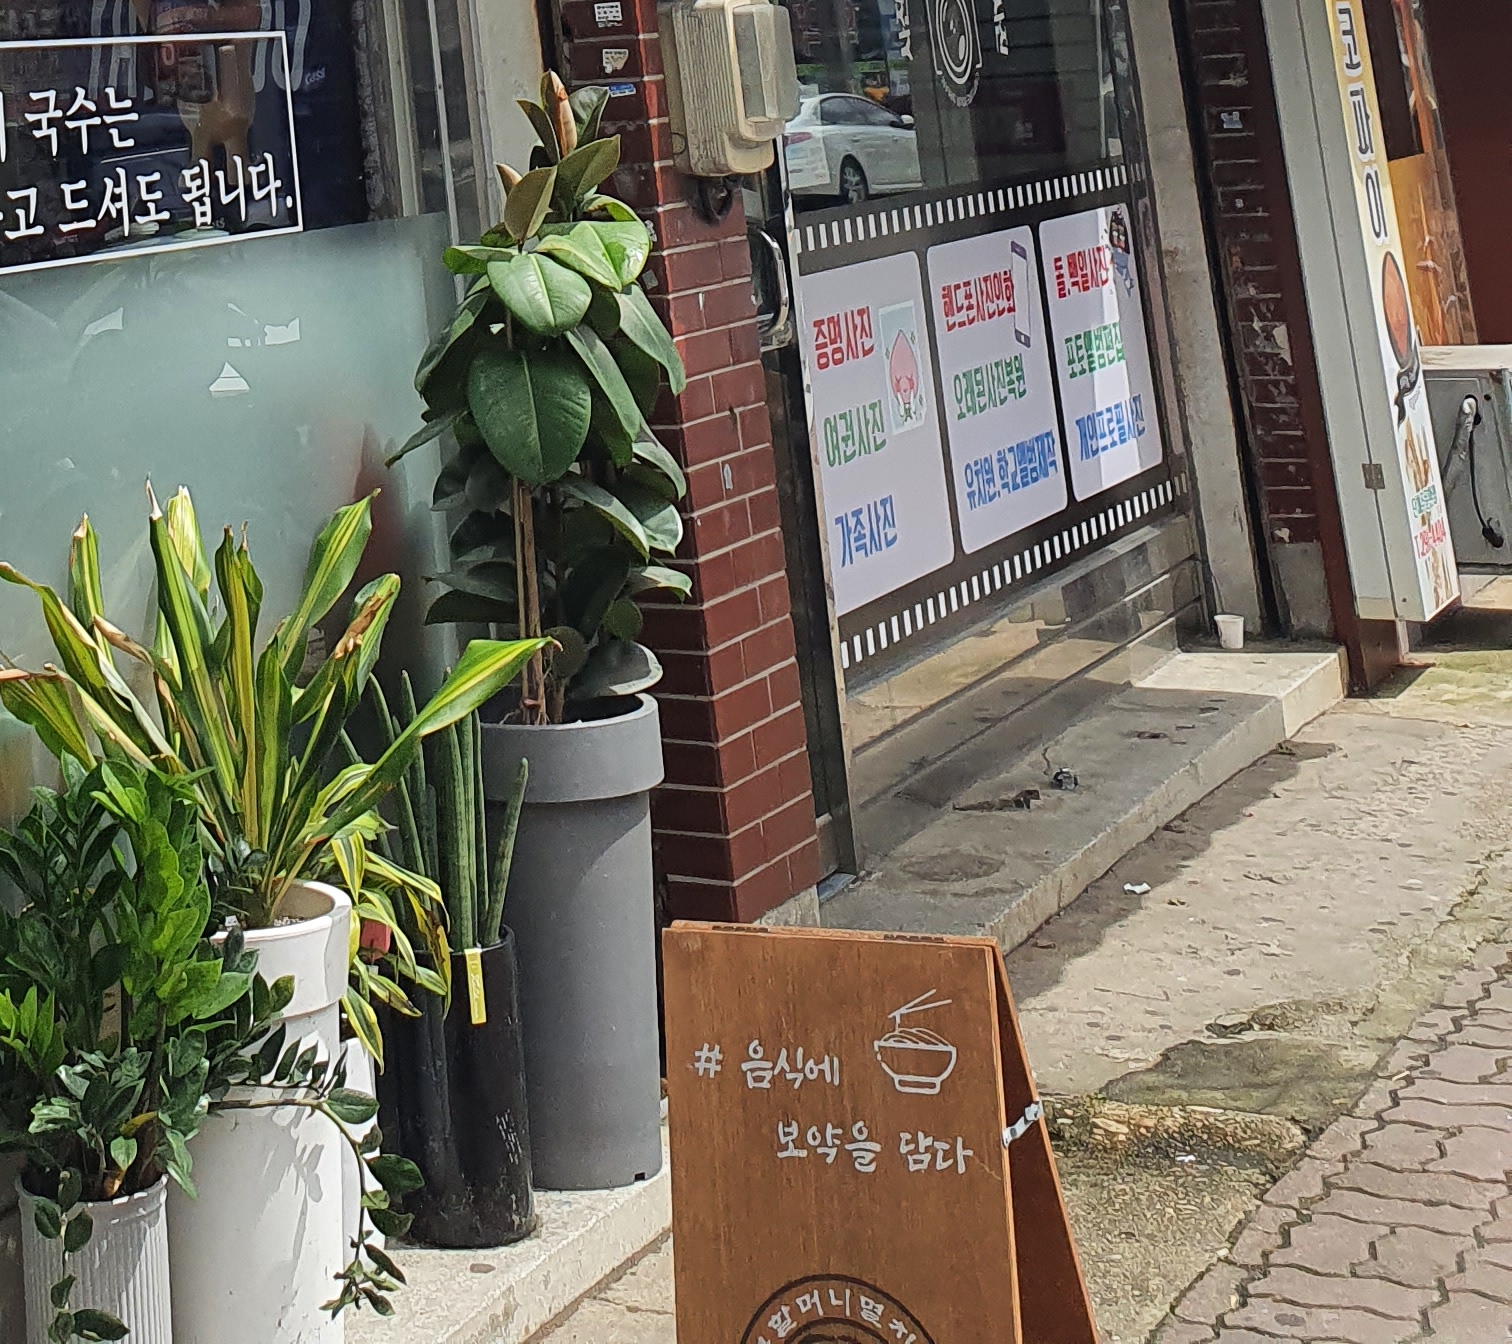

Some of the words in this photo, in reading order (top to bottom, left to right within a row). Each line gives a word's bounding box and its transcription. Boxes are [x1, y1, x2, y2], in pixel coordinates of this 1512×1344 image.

[24, 86, 140, 157] 국수는
[60, 167, 171, 237] 드셔도
[180, 151, 294, 226] 됩니다.
[812, 305, 875, 370] 증명사진
[952, 353, 1027, 421] 오래된사진복원
[822, 399, 887, 468] 여권사진
[834, 495, 898, 568] 가족사진
[741, 1039, 840, 1089] 음식에
[777, 1120, 882, 1173] 보약을
[899, 1132, 974, 1174] 담다
